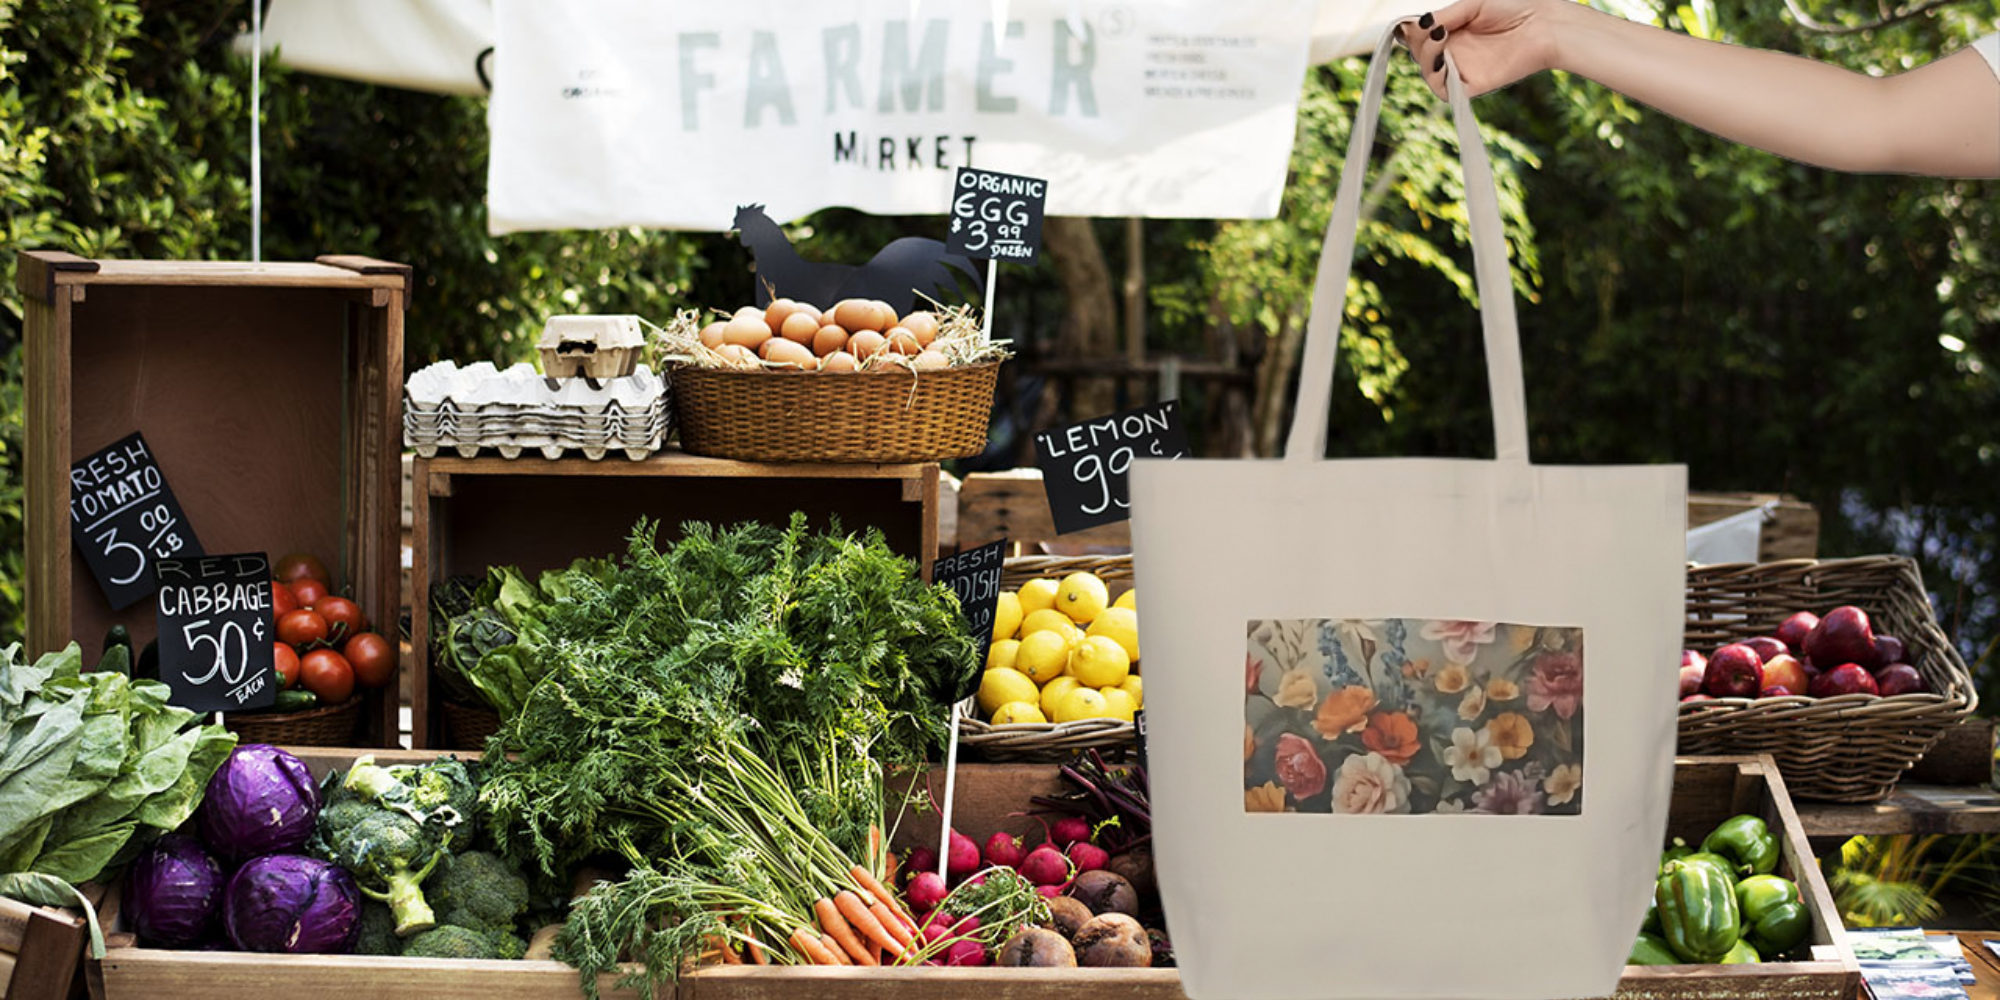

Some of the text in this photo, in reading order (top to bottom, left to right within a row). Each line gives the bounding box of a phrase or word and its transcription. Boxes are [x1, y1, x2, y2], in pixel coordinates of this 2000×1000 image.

[677, 19, 1100, 131] FARMER
[834, 131, 976, 170] MRKET
[959, 172, 1043, 198] ORGANIC
[954, 192, 1029, 226] EGG
[70, 439, 149, 492] RESH
[155, 532, 184, 558] LB
[934, 545, 999, 578] FRESH
[156, 557, 267, 579] RED
[159, 581, 271, 616] CABBAGE
[949, 567, 1001, 604] ADISH
[235, 676, 265, 704] EACH
